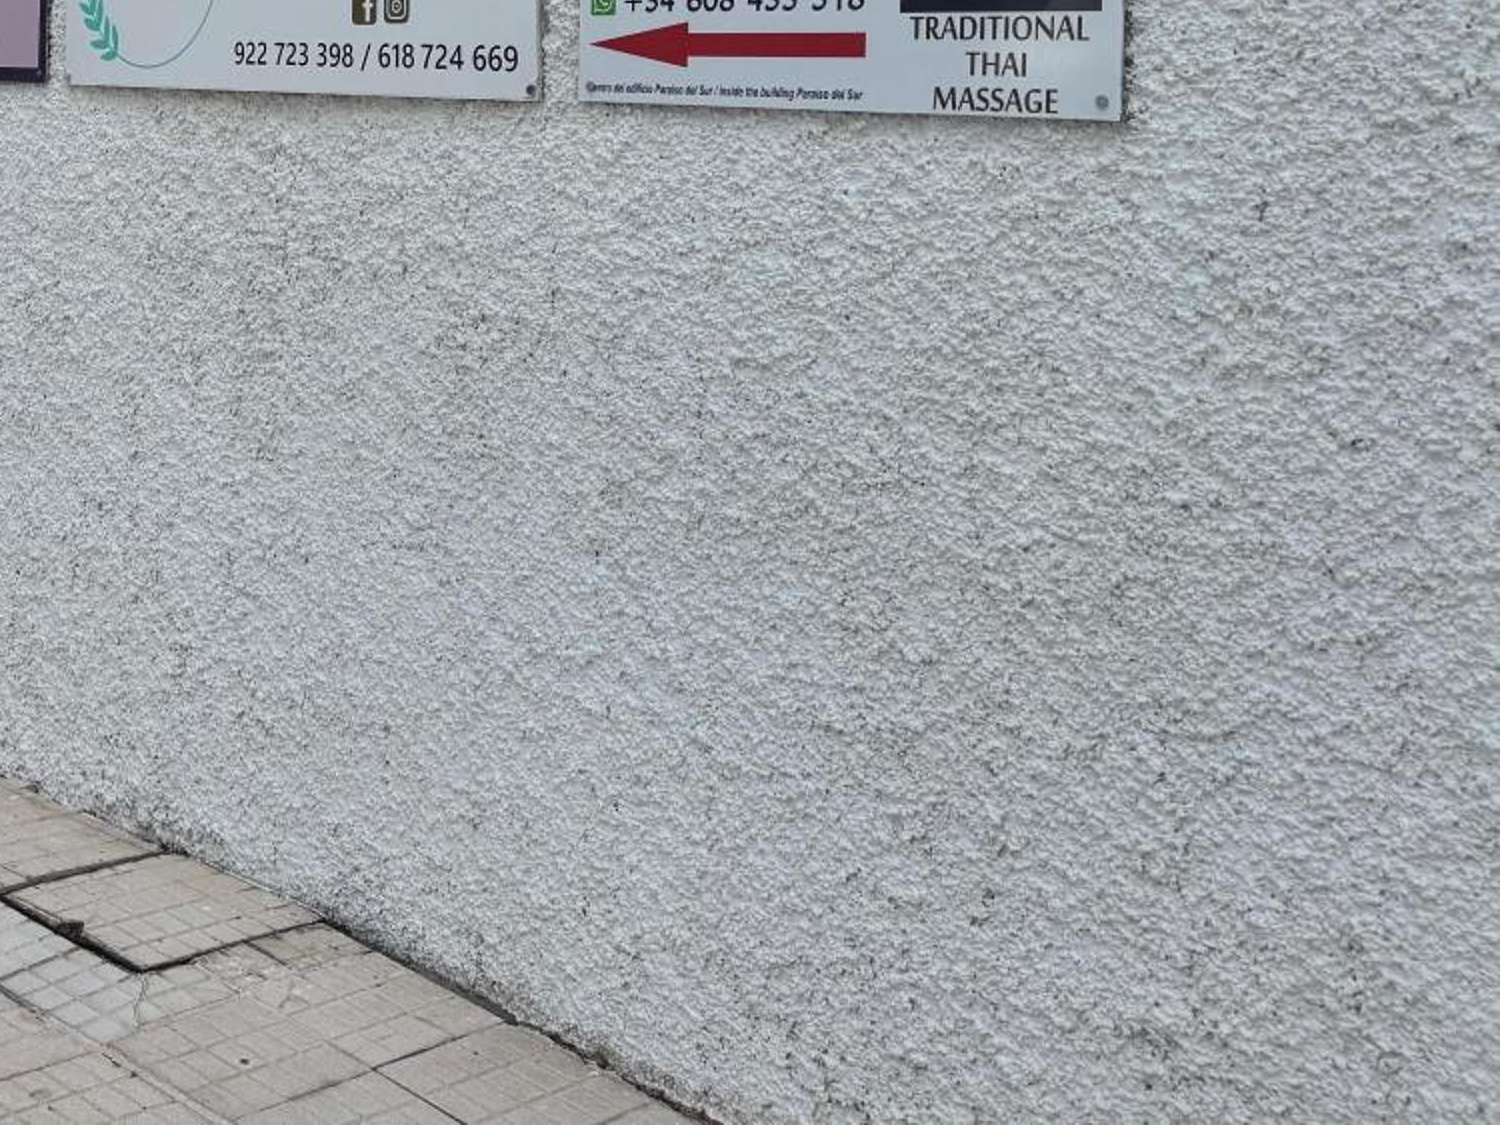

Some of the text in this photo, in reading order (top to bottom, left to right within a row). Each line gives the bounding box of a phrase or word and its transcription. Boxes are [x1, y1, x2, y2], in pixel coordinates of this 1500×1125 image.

[910, 15, 1090, 41] TRADITIONAL
[234, 42, 518, 72] 922 723 398 / 618 724 669
[966, 51, 1027, 77] THAI
[933, 86, 1059, 114] MASSAGE
